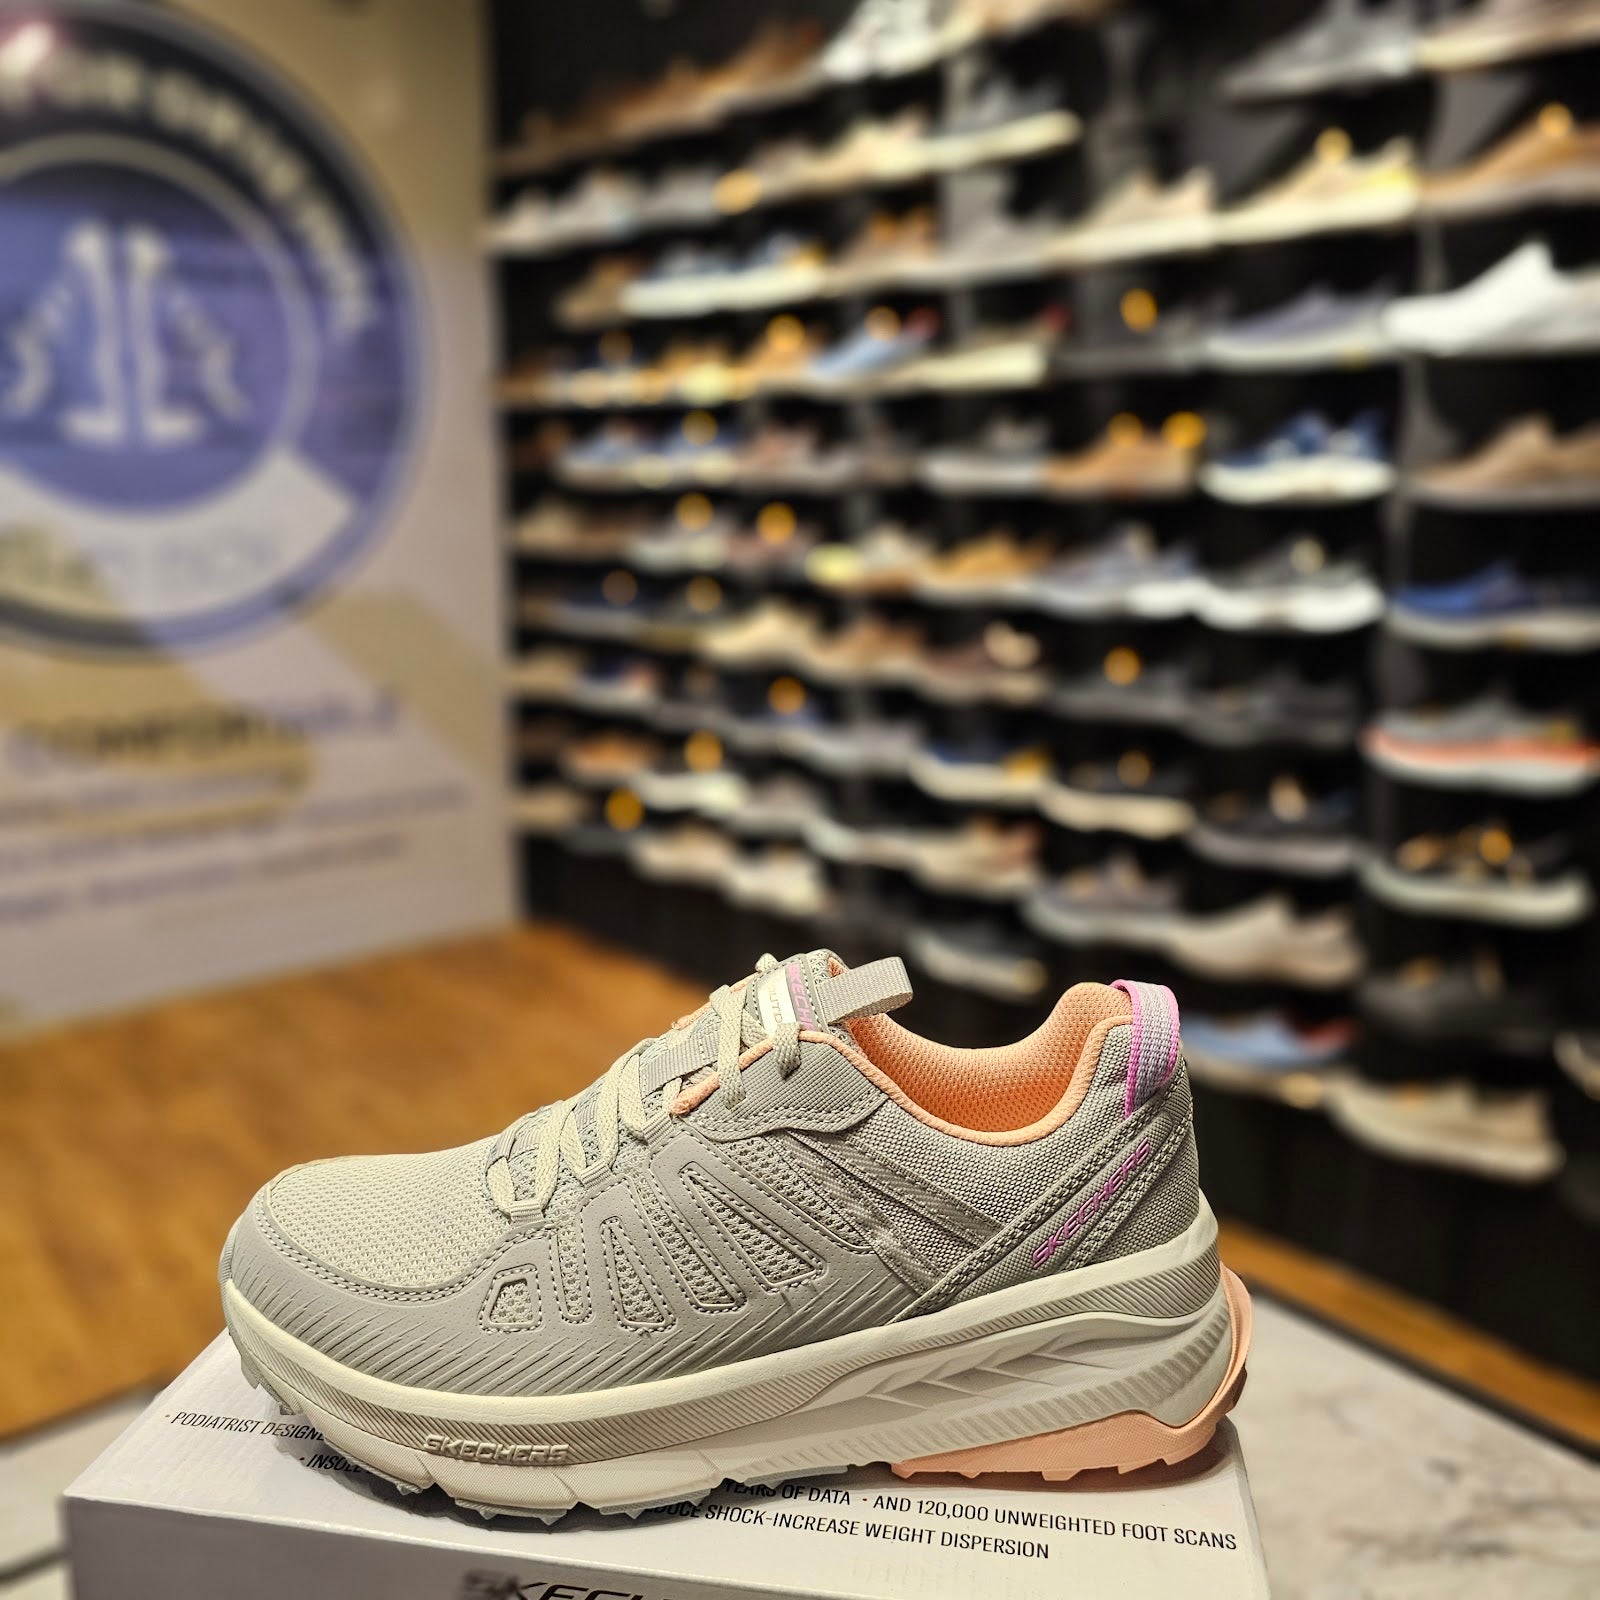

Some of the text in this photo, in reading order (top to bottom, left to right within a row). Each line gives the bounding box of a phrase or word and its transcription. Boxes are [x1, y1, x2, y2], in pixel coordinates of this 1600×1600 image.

[1032, 1137, 1150, 1269] SKECHERS
[171, 1411, 264, 1434] PODIATRIST
[782, 1484, 804, 1500] OF
[808, 1487, 851, 1506] DATA
[873, 1495, 911, 1512] AND
[917, 1500, 989, 1522] 120,000
[994, 1508, 1116, 1536] UNWEIGHTED
[1122, 1523, 1168, 1542] FOOT
[1173, 1528, 1237, 1550] SCANS
[424, 1434, 569, 1463] SKECHERS
[705, 1504, 861, 1536] SHOCK-INCREASE
[865, 1523, 936, 1545] WEIGHT
[940, 1531, 1049, 1559] DISPERSION
